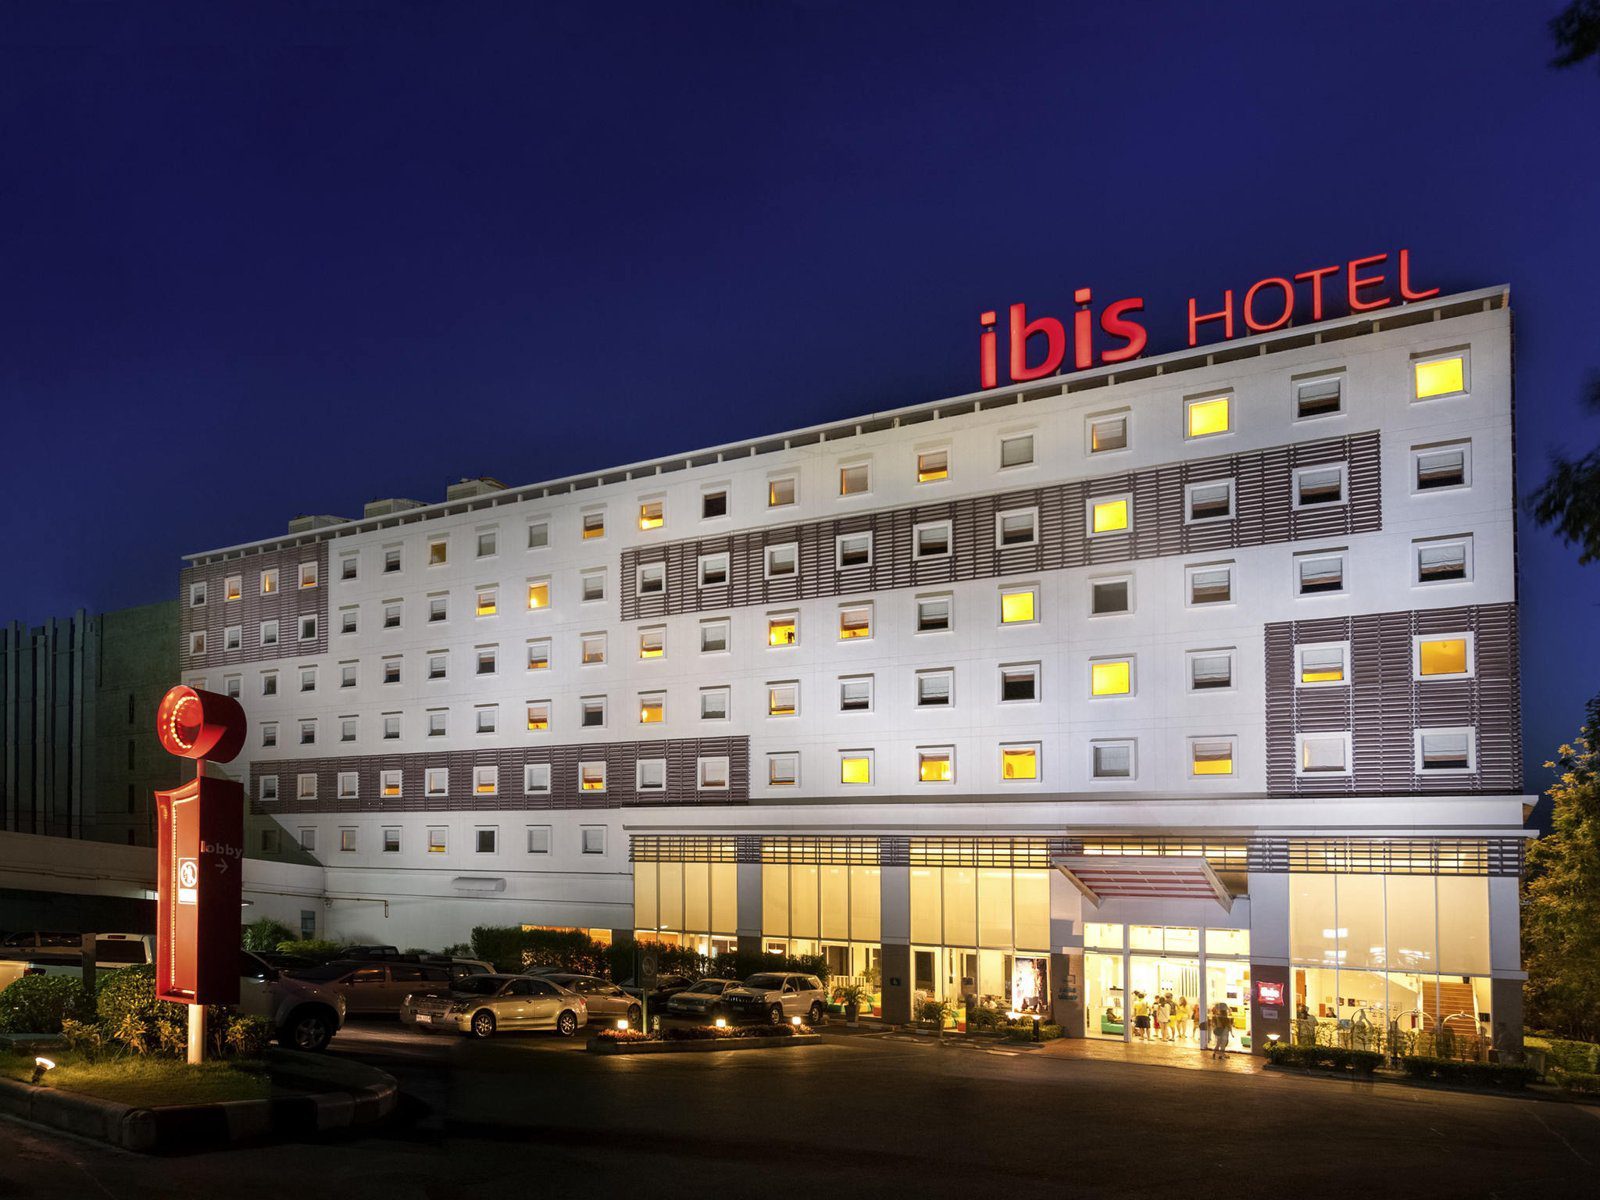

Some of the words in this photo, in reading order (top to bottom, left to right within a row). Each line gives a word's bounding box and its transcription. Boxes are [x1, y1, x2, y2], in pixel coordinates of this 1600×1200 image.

[980, 288, 1147, 389] ibis
[1188, 249, 1440, 346] HOTEL
[200, 840, 242, 859] lobby
